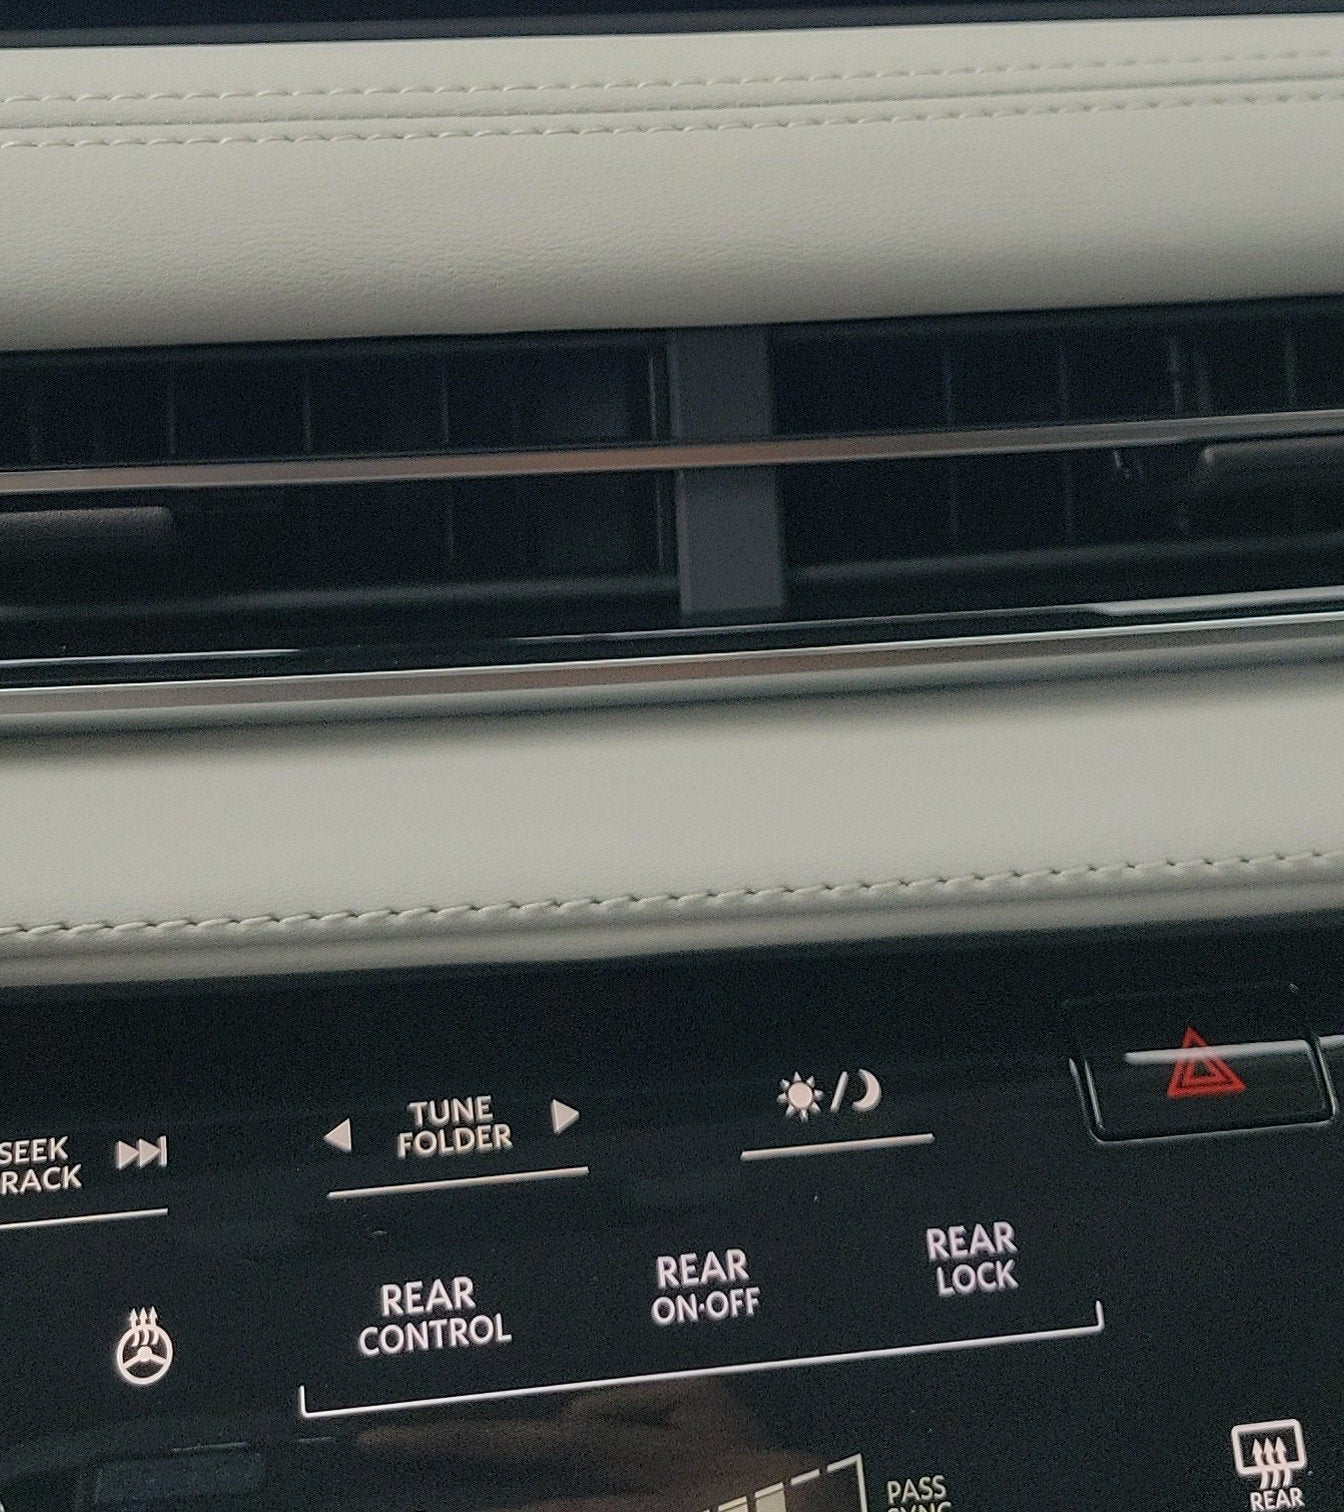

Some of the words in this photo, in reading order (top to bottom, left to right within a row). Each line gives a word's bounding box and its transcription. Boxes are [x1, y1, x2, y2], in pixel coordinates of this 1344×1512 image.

[409, 1096, 493, 1126] TUNE
[399, 1123, 513, 1157] FOLDER
[927, 1223, 1016, 1259] REAR
[658, 1250, 748, 1287] REAR
[938, 1260, 1017, 1295] LOCK
[382, 1277, 475, 1315] REAR
[359, 1313, 512, 1355] CONTROL
[887, 1475, 946, 1504] PASS
[1250, 1487, 1305, 1511] REAR
